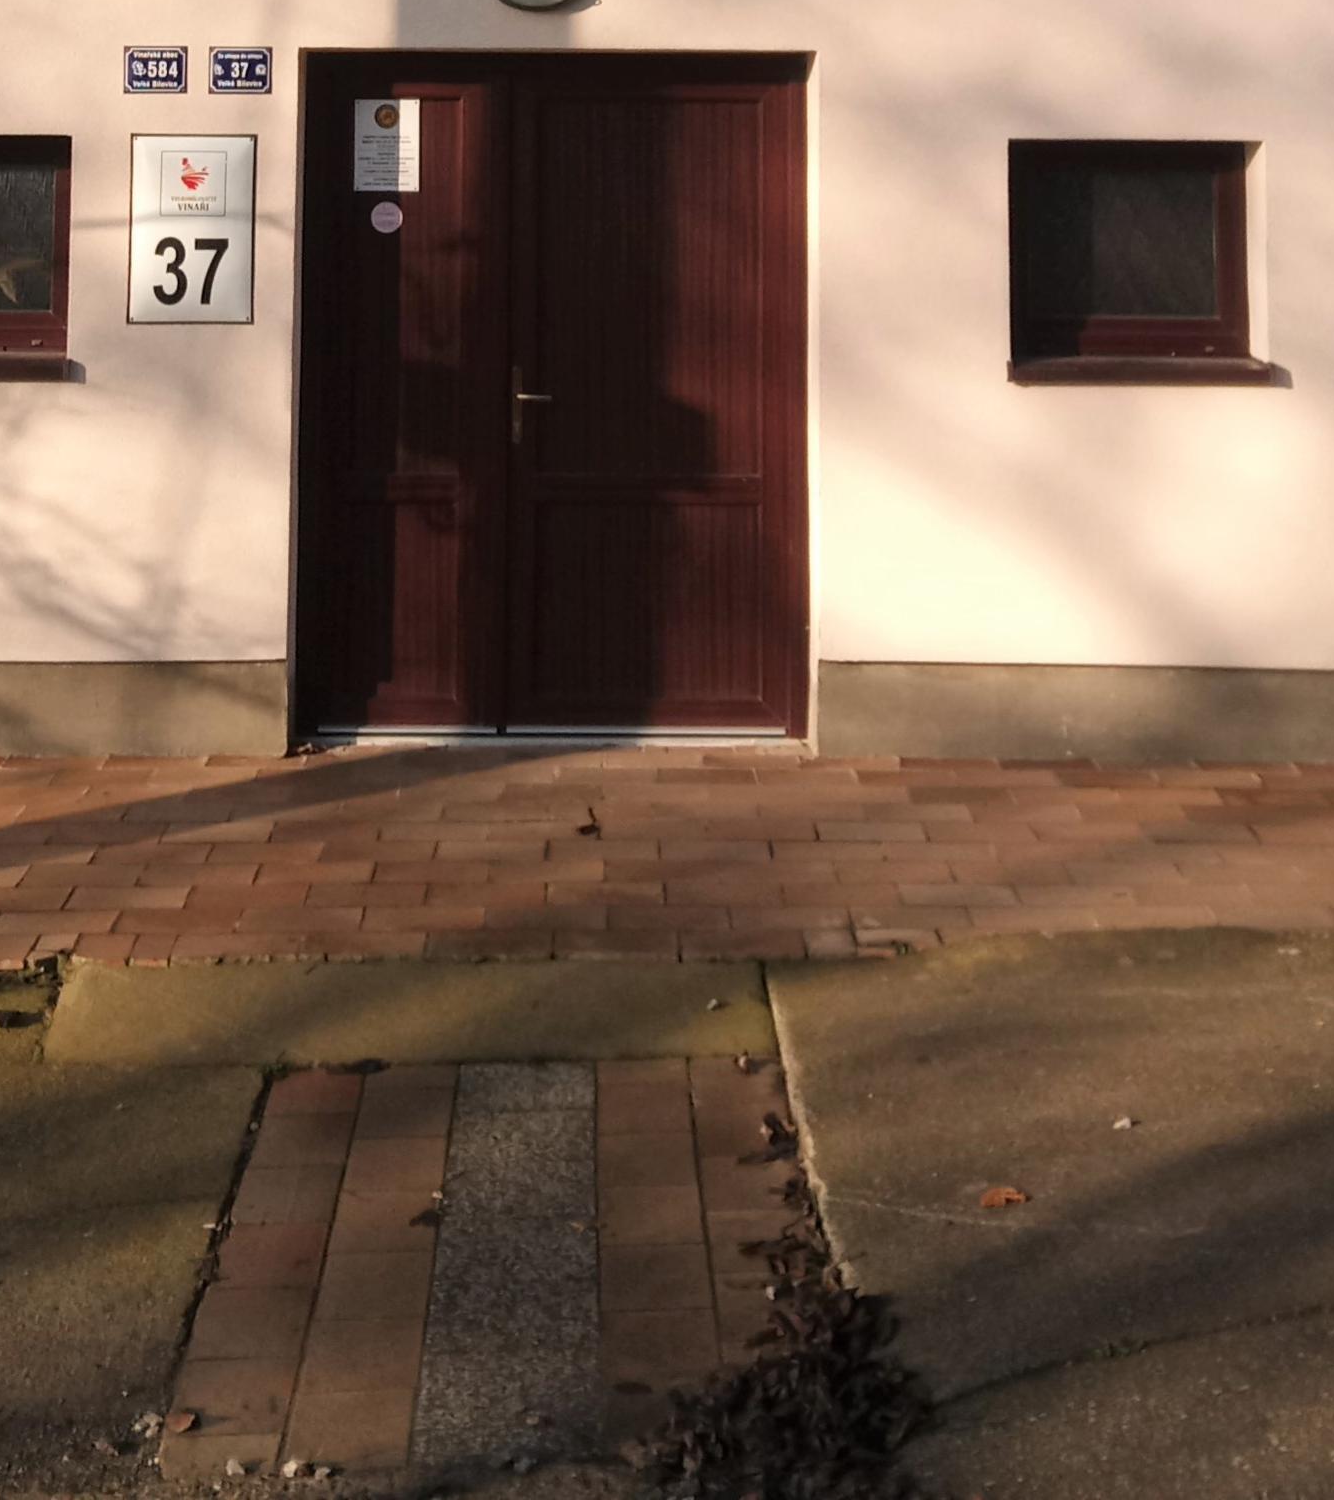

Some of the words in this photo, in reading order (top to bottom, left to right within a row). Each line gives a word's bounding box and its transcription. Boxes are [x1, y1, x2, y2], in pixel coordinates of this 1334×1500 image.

[147, 61, 179, 78] 584
[230, 61, 249, 78] 37
[153, 236, 229, 306] 37
